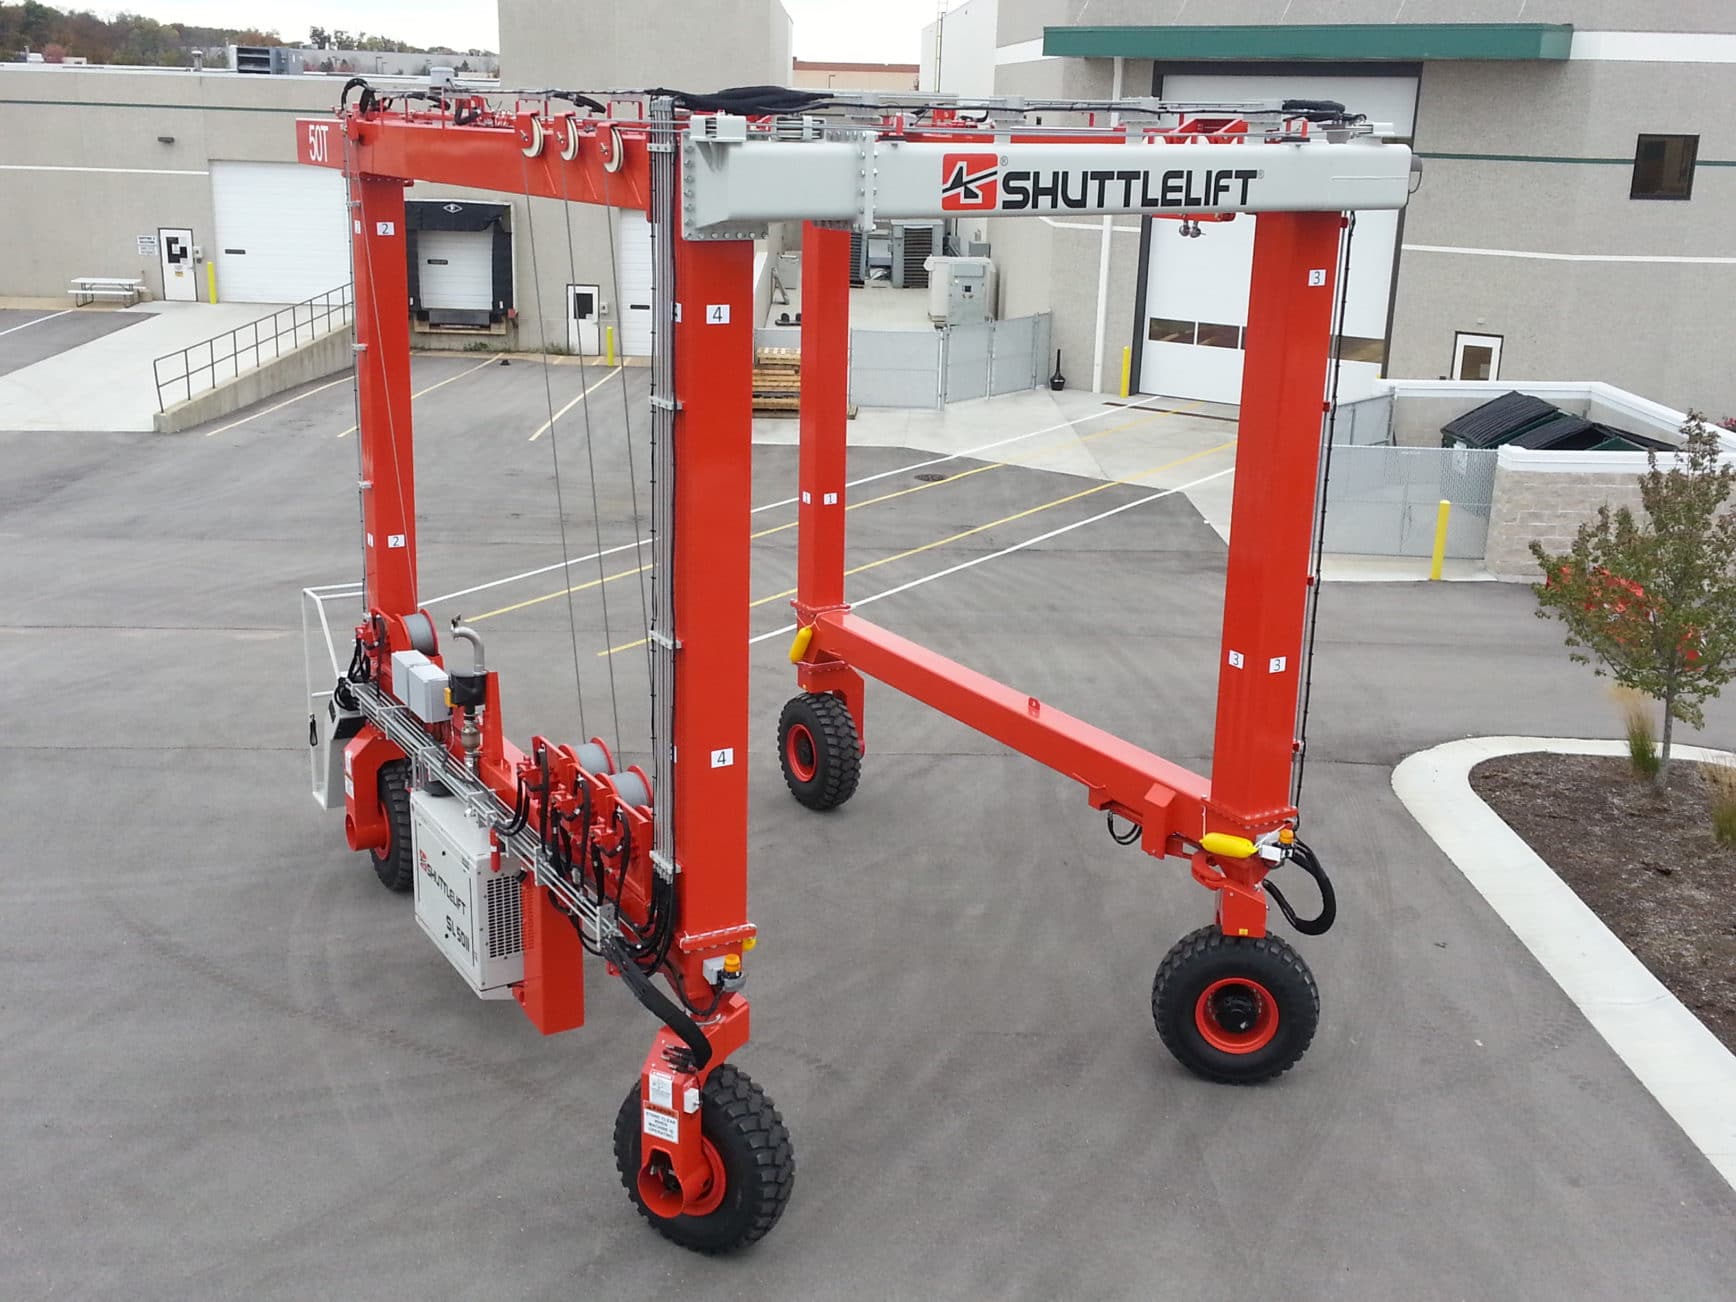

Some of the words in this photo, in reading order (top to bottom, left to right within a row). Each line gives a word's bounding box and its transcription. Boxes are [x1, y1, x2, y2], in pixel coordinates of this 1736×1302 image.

[309, 124, 328, 162] 50T
[1002, 169, 1258, 209] SHUTTLELIFT
[382, 223, 389, 234] 2
[1313, 271, 1321, 285] 3
[712, 306, 723, 322] 4
[392, 536, 399, 546] 2
[1232, 653, 1239, 666] 3
[1273, 659, 1281, 671] 3
[717, 751, 727, 765] 4
[426, 863, 466, 915] SHUTTLELIFT
